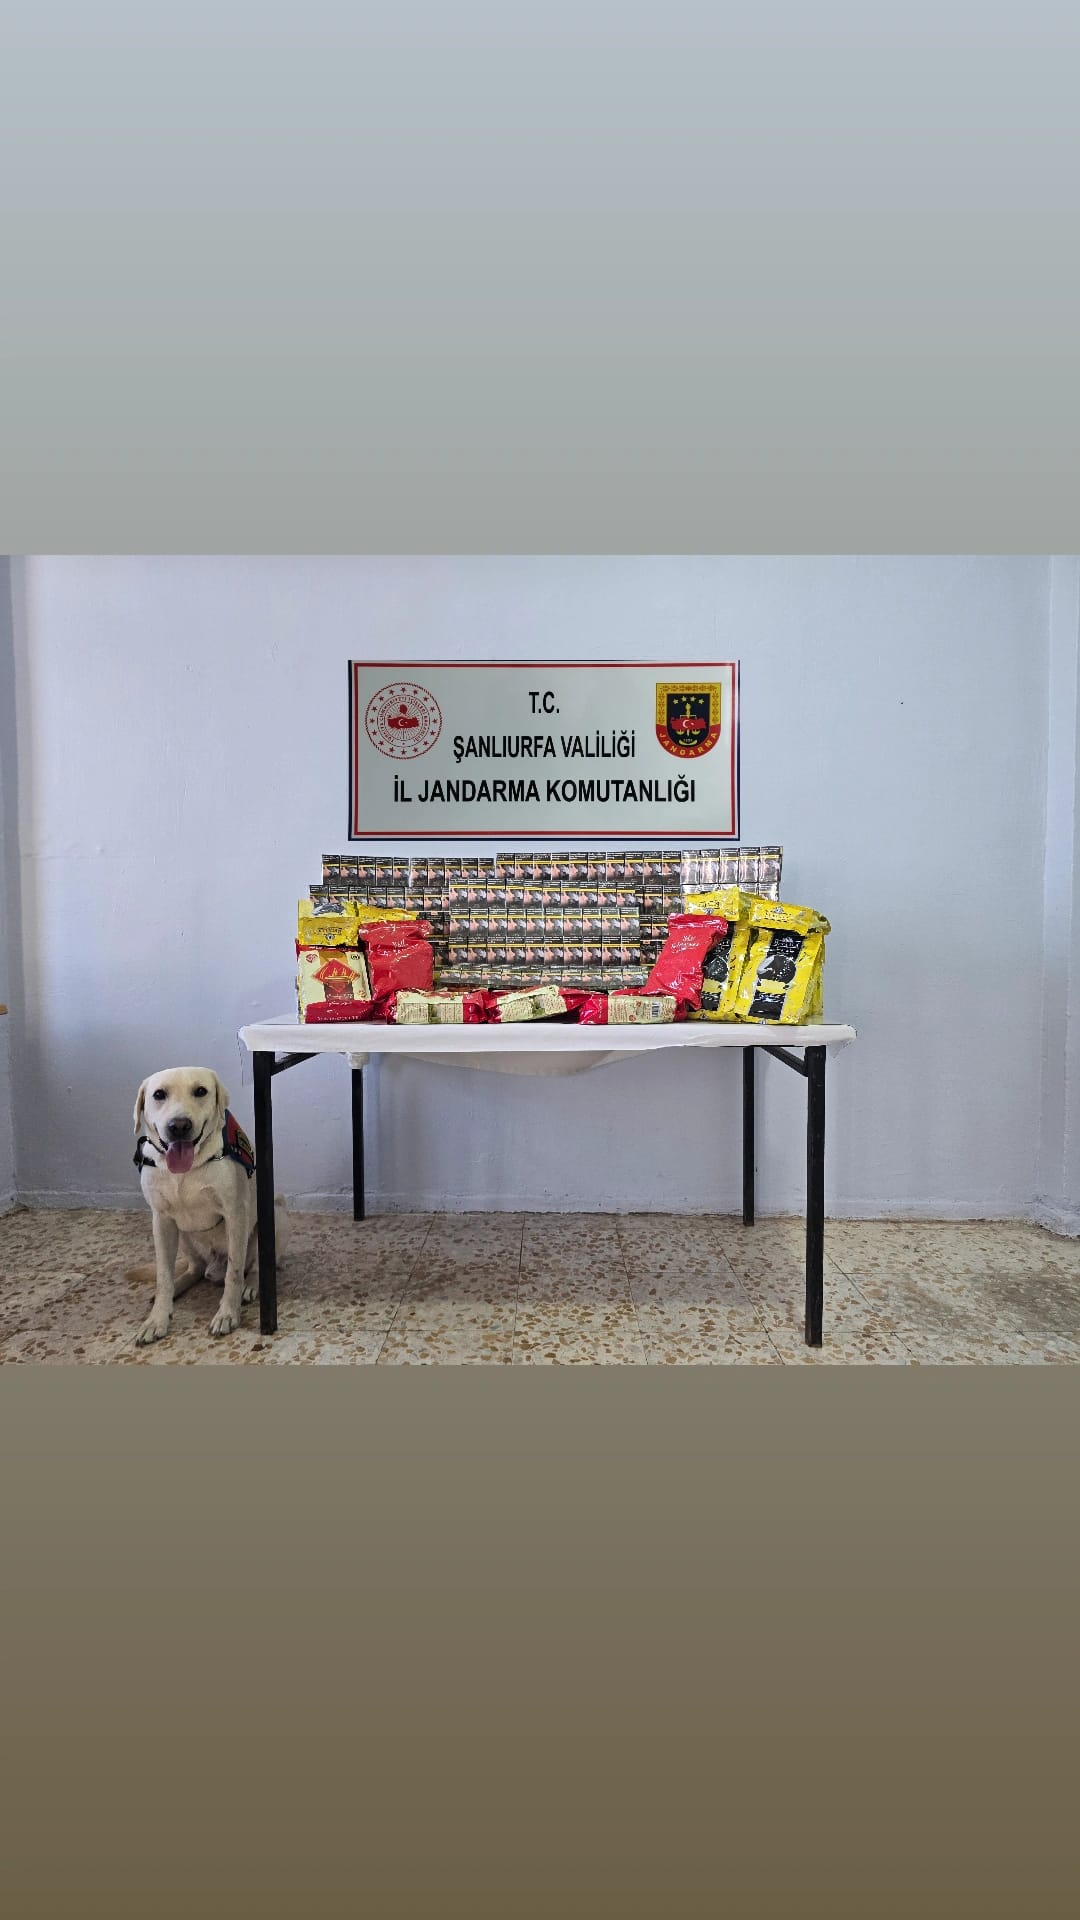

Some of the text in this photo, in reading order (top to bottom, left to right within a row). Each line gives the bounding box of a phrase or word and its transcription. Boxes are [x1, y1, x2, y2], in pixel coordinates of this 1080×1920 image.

[528, 690, 560, 714] T.C.
[453, 730, 636, 763] ŞANLIURFA VALİLİĞİ
[659, 732, 719, 756] JANDARMA
[393, 774, 696, 802] İL JANDARMA KOMUTANLIĞI
